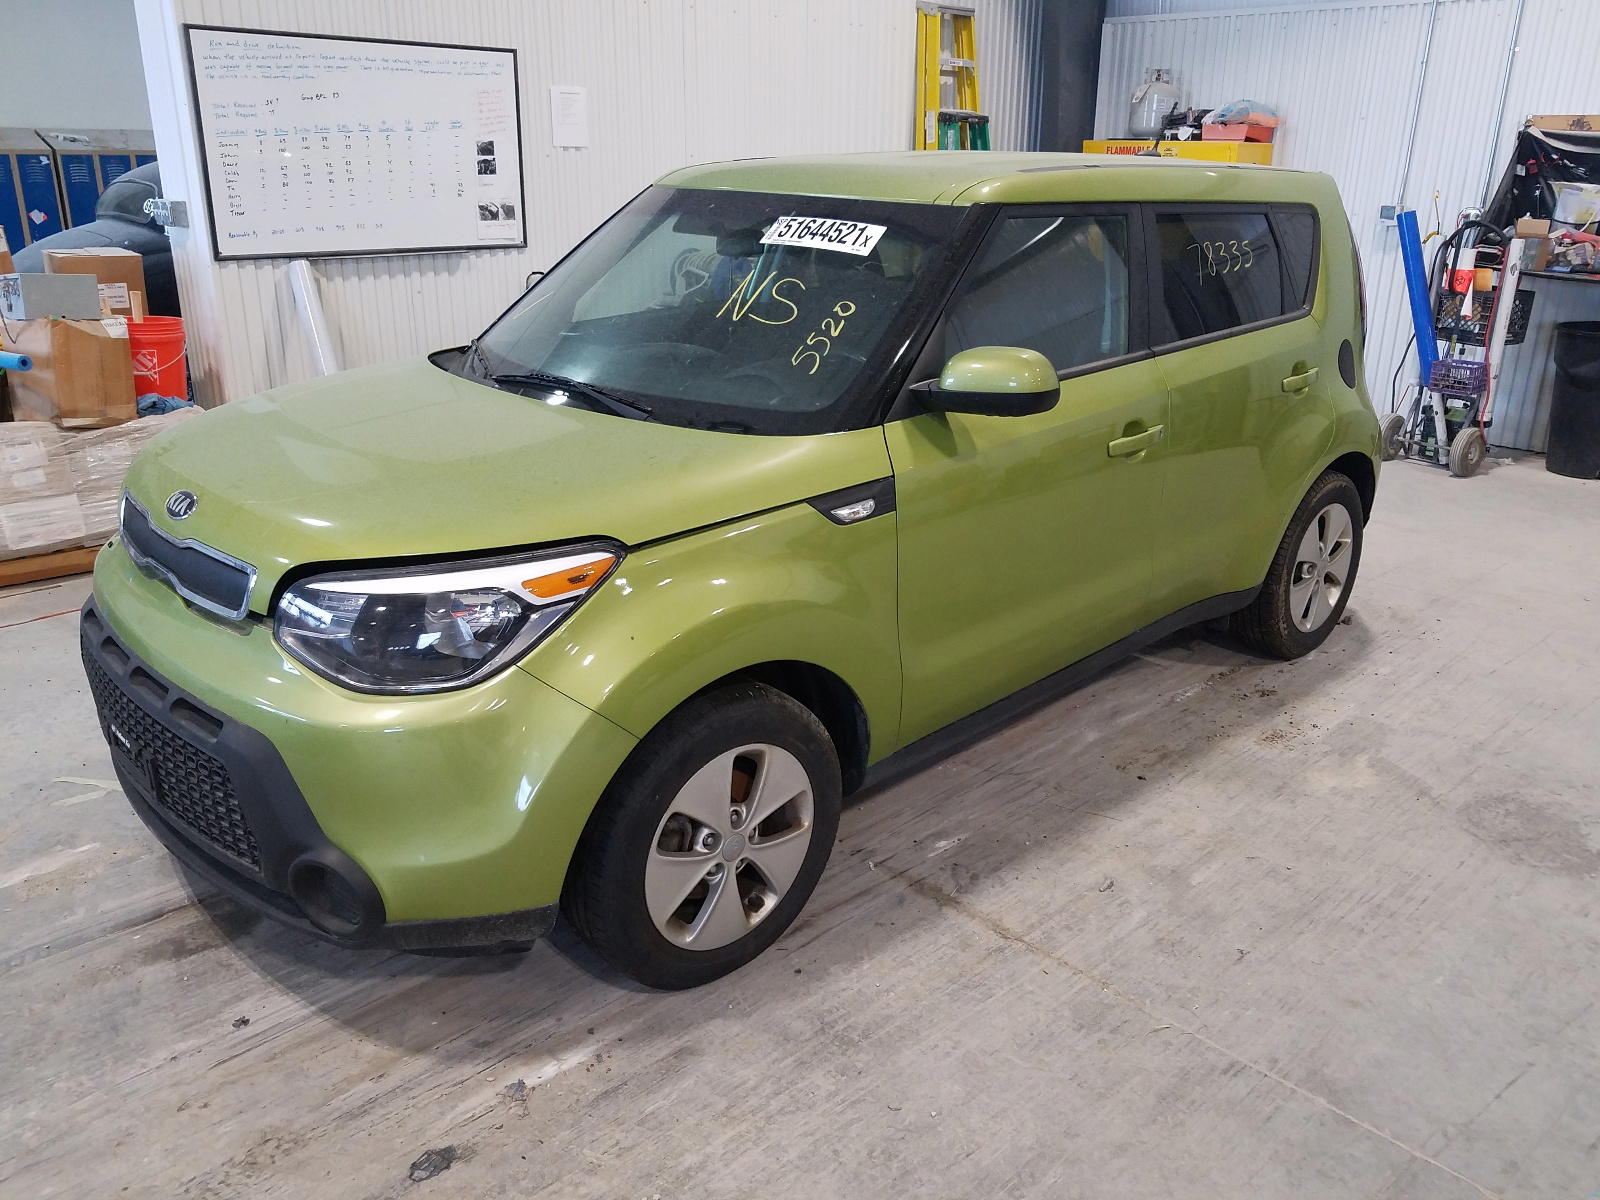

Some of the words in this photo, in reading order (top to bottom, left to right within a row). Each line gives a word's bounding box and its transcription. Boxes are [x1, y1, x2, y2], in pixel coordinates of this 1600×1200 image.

[1186, 240, 1254, 287] 78335
[716, 269, 806, 325] NS
[791, 301, 857, 375] 5520
